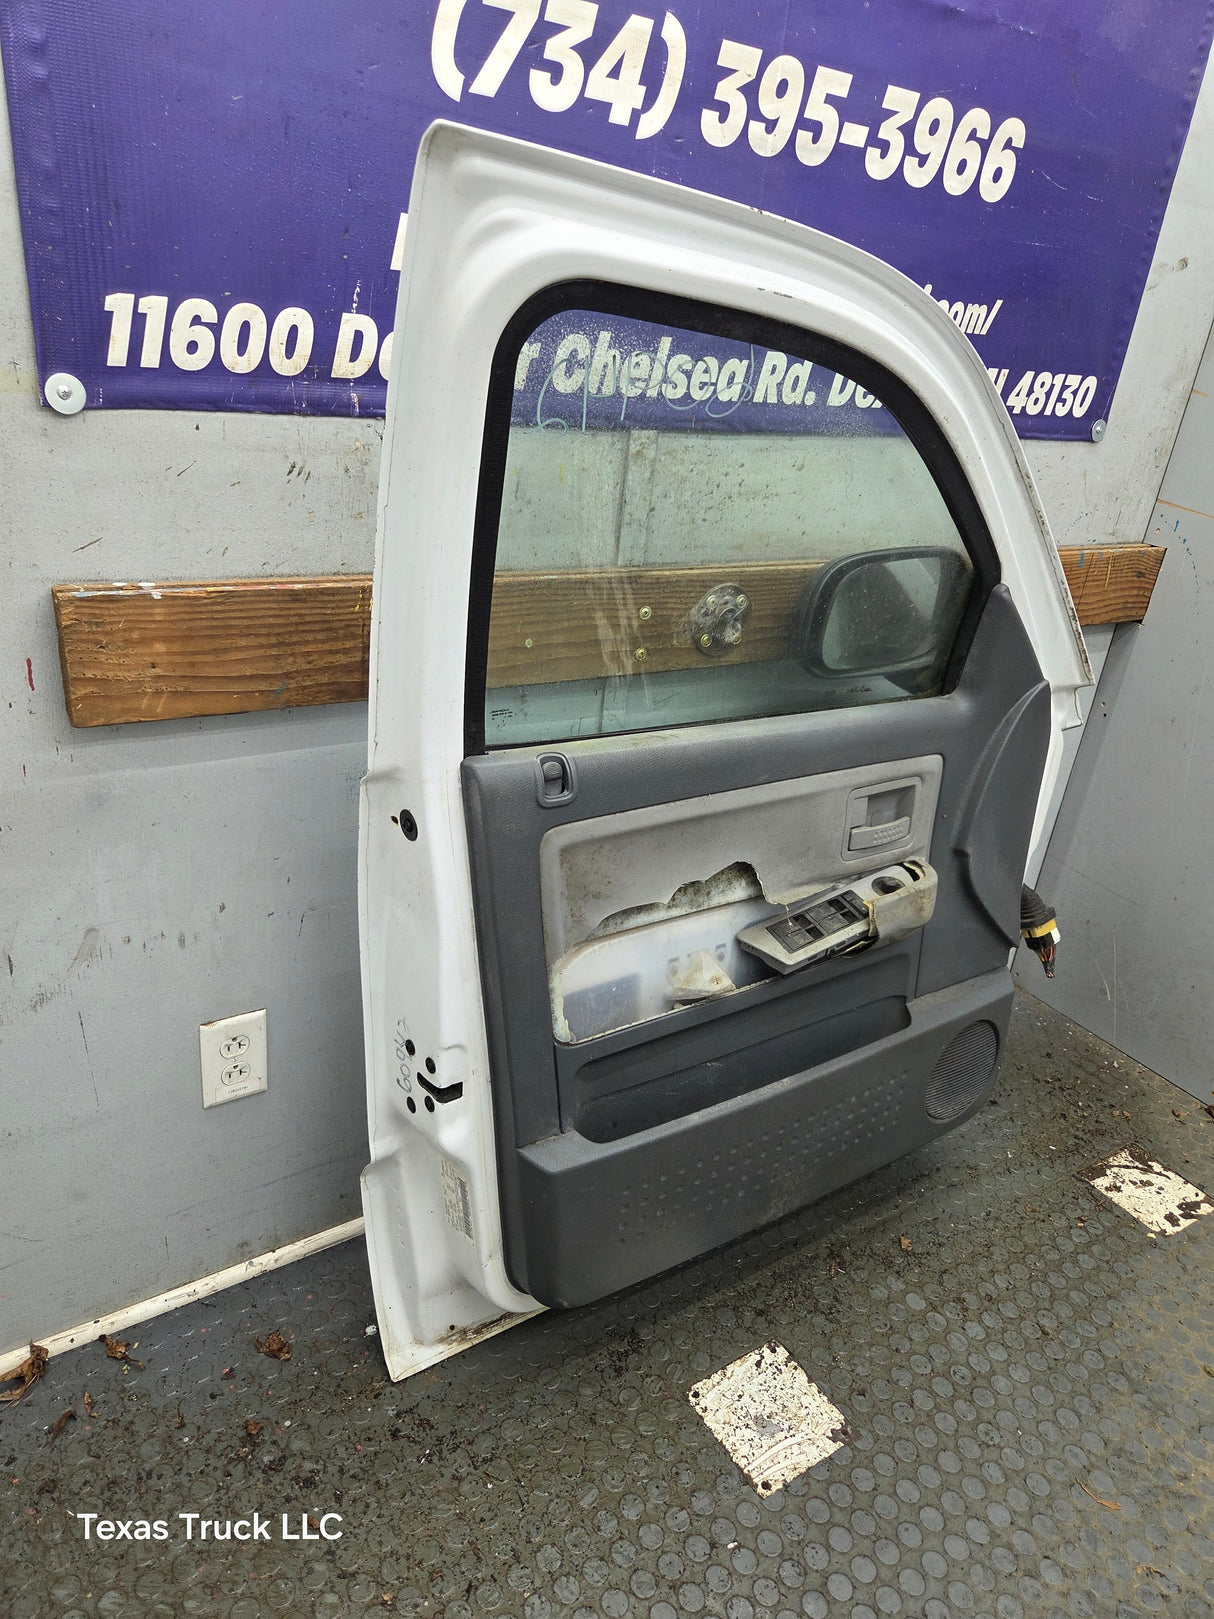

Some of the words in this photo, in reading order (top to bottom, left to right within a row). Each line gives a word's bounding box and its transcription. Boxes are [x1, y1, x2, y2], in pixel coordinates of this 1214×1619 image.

[431, 0, 687, 140] (734)
[700, 38, 1027, 204] 395-3966
[104, 292, 314, 375] 11600
[552, 331, 751, 402] Chelsea
[753, 350, 817, 406] Rd.
[1006, 370, 1098, 418] 48130
